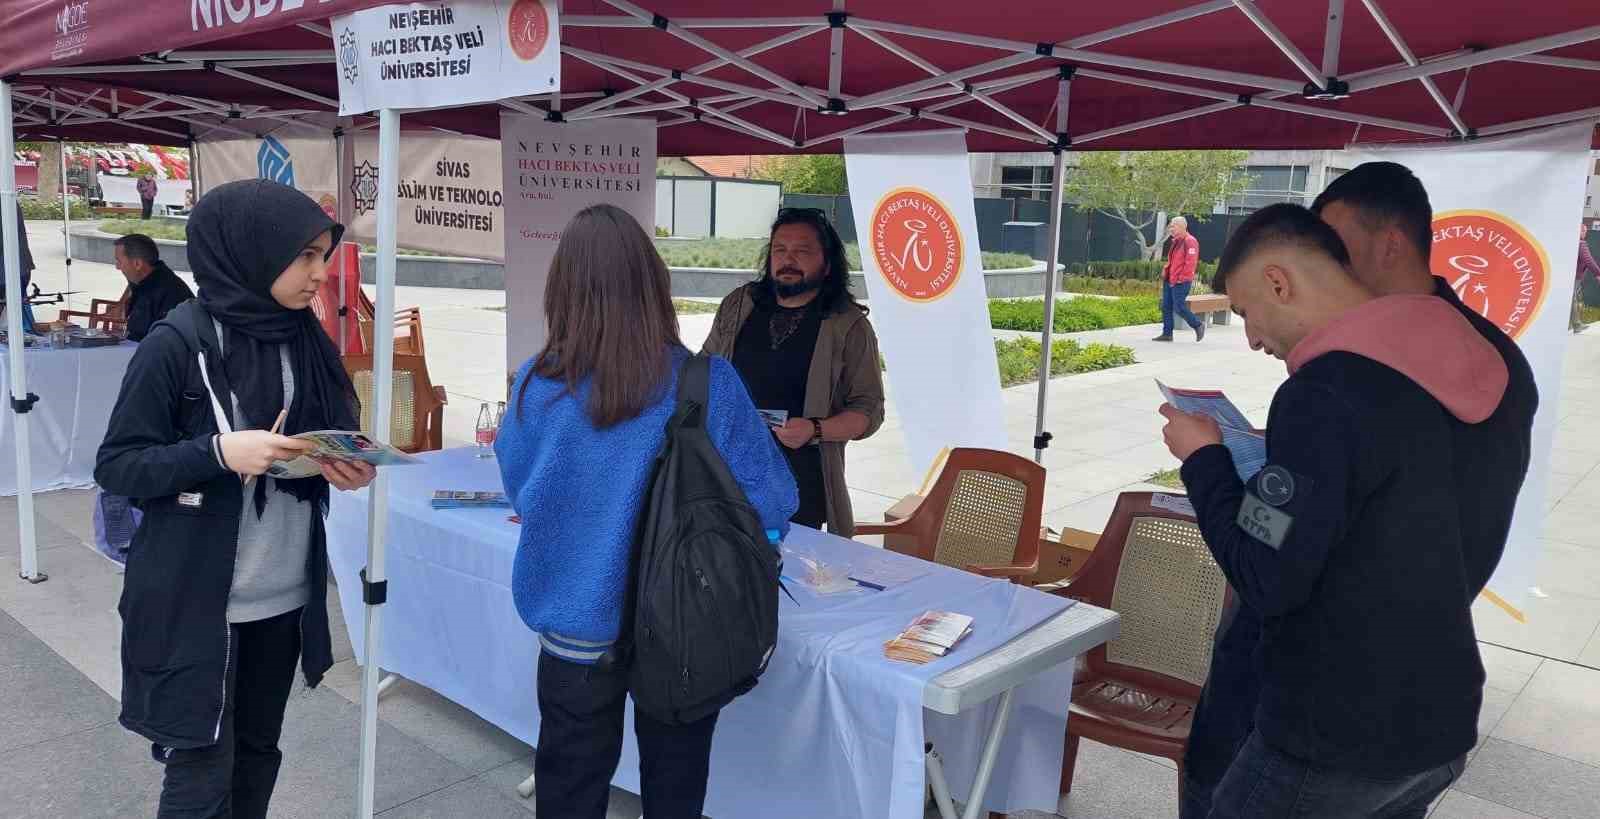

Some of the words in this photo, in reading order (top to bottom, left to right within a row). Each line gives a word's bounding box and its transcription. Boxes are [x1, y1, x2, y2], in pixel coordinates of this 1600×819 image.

[389, 4, 455, 31] NEVŞEHİR
[371, 41, 397, 57] HACI
[399, 35, 453, 56] BEKTAŞ
[455, 25, 484, 50] VELİ
[381, 54, 472, 81] ÜNİVERSİTESİ
[518, 141, 641, 158] NEVŞEHİR
[436, 157, 471, 179] SİVAS
[518, 159, 553, 171] HACI
[555, 160, 606, 175] BEKTAŞ
[609, 161, 641, 175] VELİ
[519, 173, 641, 192] ÜNİVERSİTESİ
[429, 186, 444, 202] VE
[446, 187, 505, 207] TEKNOLO
[415, 205, 493, 233] ÜNİVERSİTESİ
[1432, 224, 1486, 244] EKTAŞ
